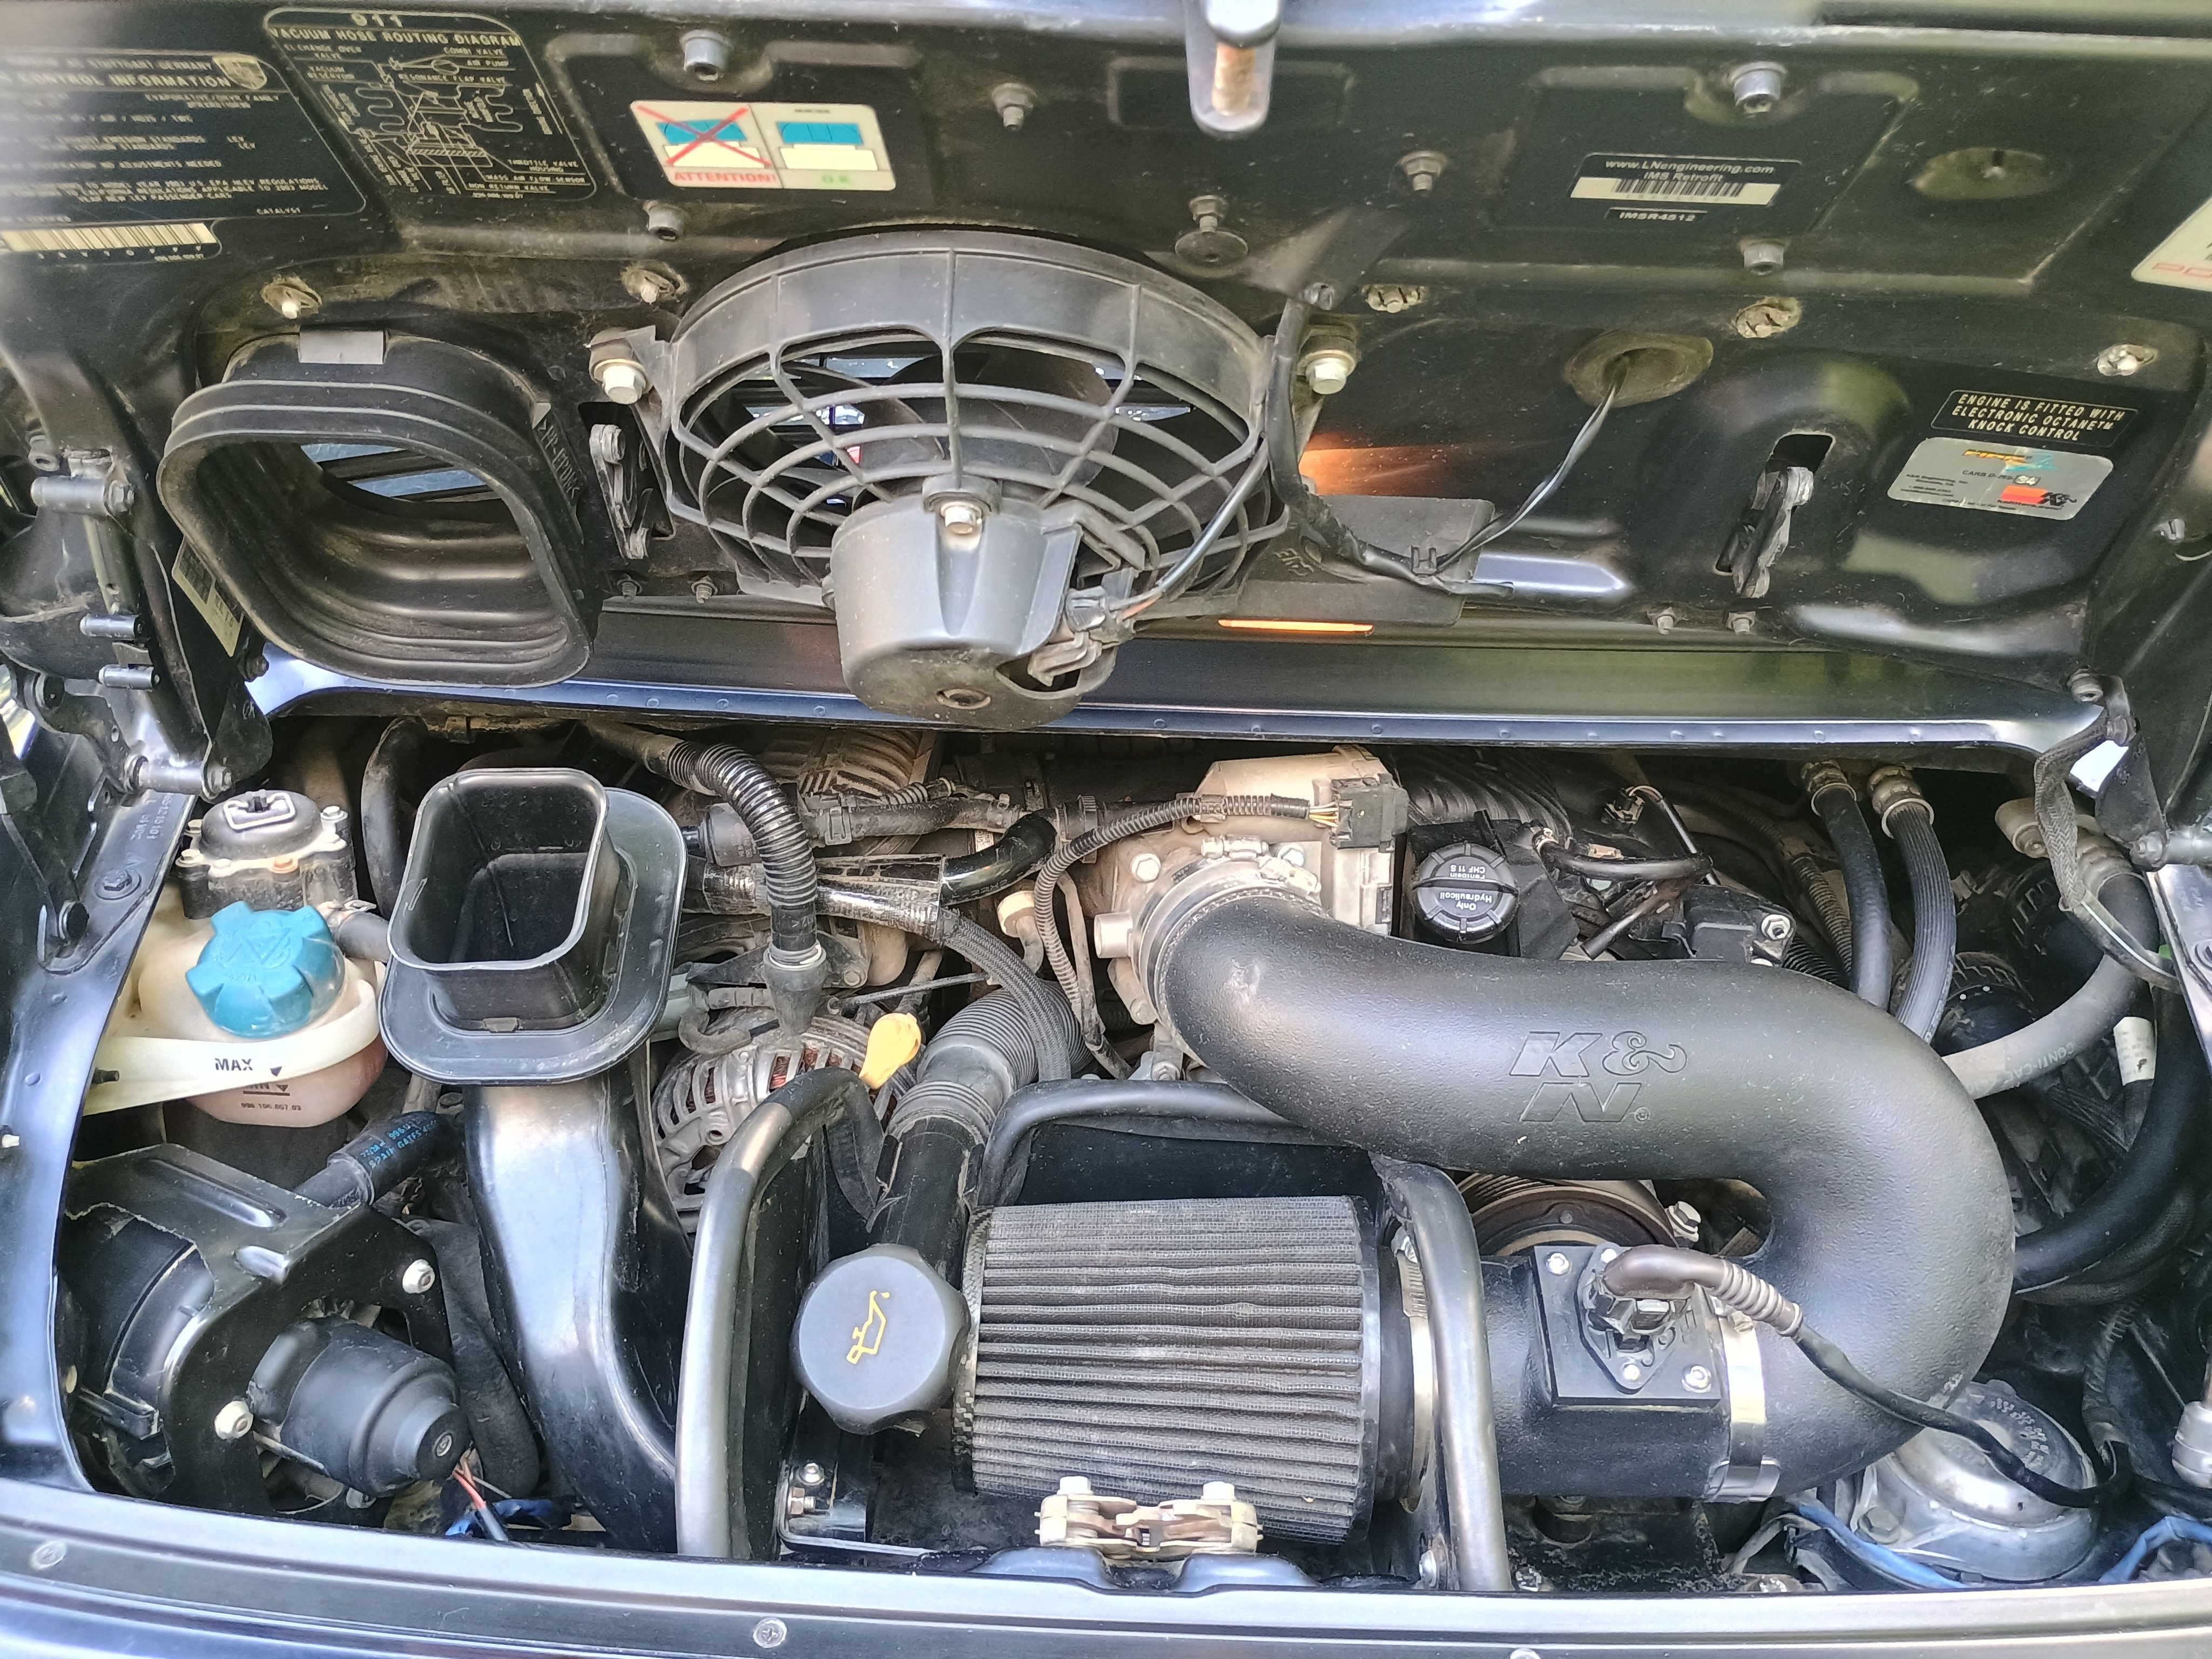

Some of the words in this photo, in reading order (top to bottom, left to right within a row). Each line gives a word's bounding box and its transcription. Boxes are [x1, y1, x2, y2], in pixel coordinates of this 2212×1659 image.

[351, 14, 403, 27] 911
[270, 28, 331, 39] VACUUM
[335, 30, 377, 41] HOSE
[382, 31, 449, 44] ROUTING
[454, 33, 521, 46] DIAGRAM
[109, 73, 231, 87] INFORMATION
[1605, 160, 1774, 174] www.LNengineering.com
[674, 171, 776, 184] ATTENTION!
[1644, 172, 1669, 180] IMS
[1673, 172, 1724, 183] Retrofit
[1958, 394, 2011, 408] ENGINE
[2015, 400, 2031, 411] IS
[2034, 402, 2085, 417] FITTED
[2089, 409, 2125, 421] WITH
[1952, 405, 2038, 424] ELECTRONIC
[1968, 419, 2015, 433] KNOCK
[2019, 424, 2079, 441] CONTROL
[1450, 864, 1456, 872] S
[1468, 866, 1486, 874] CHF
[1440, 892, 1492, 903] Hydraulicoil
[1456, 900, 1476, 911] Only
[214, 1057, 253, 1071] MAX
